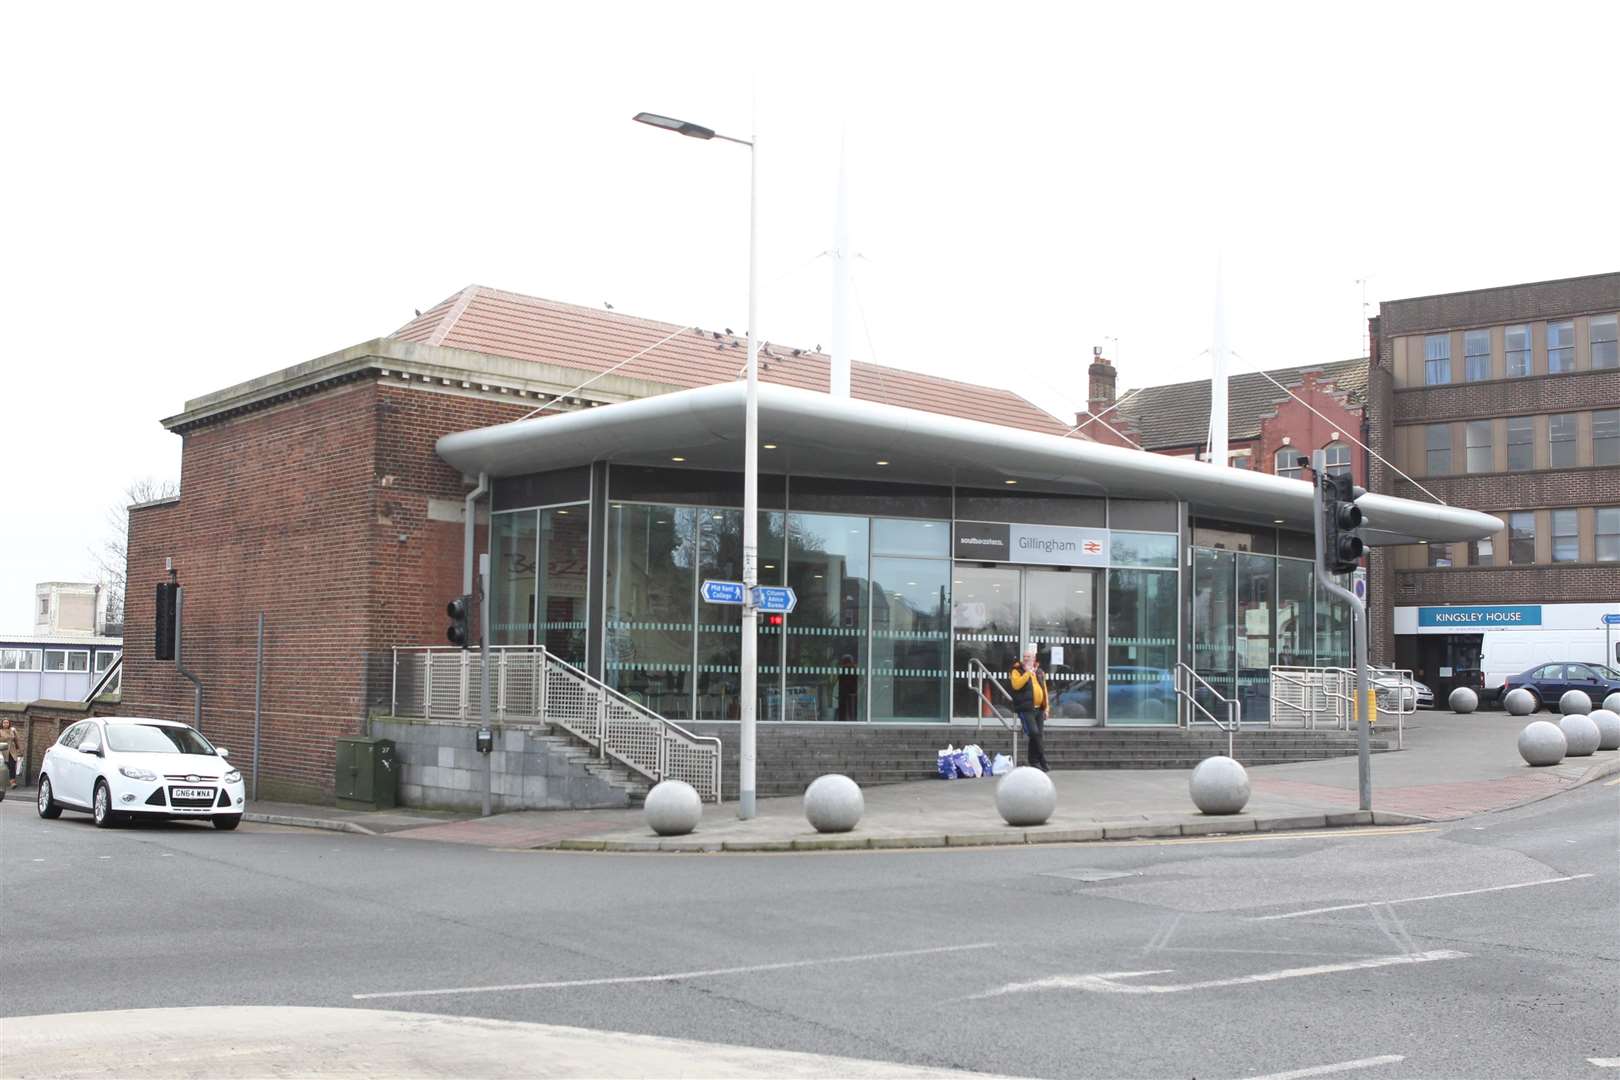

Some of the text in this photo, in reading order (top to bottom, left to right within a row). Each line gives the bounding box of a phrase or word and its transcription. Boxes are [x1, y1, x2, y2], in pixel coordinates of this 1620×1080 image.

[1019, 536, 1076, 552] Gillingham
[712, 591, 732, 599] College
[1435, 612, 1521, 622] KINGSLEY HOUSE
[176, 789, 194, 797] GN64
